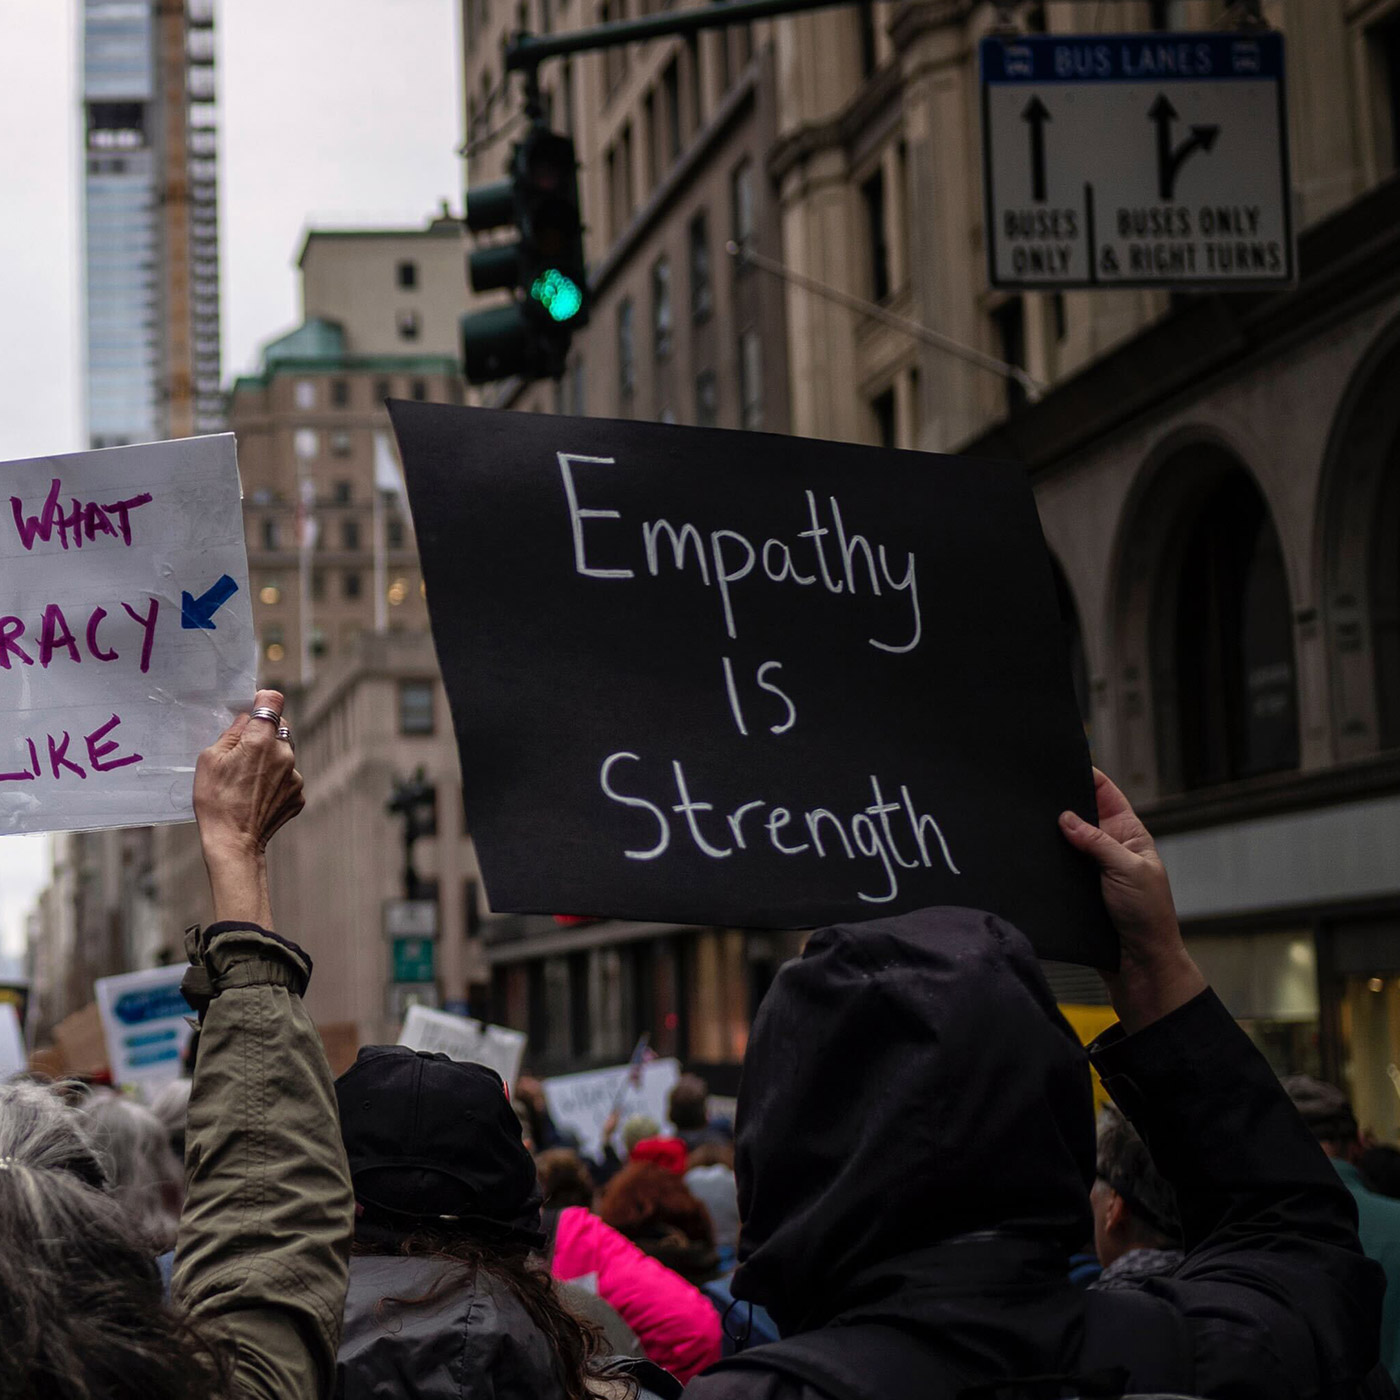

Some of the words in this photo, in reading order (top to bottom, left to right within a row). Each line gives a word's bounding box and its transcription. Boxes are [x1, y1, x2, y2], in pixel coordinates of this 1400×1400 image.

[1054, 45, 1111, 76] BUS
[1121, 43, 1211, 75] LANES
[1004, 208, 1078, 240] BUSES
[1116, 206, 1191, 238] BUSES
[1199, 205, 1259, 235] ONLY
[1012, 245, 1072, 274] ONLY
[1100, 245, 1119, 272] &
[1129, 243, 1195, 272] RIGHT
[1206, 241, 1281, 271] TURNS
[10, 478, 152, 550] WHAT
[557, 451, 922, 653] Empathy
[600, 751, 960, 902] Strength
